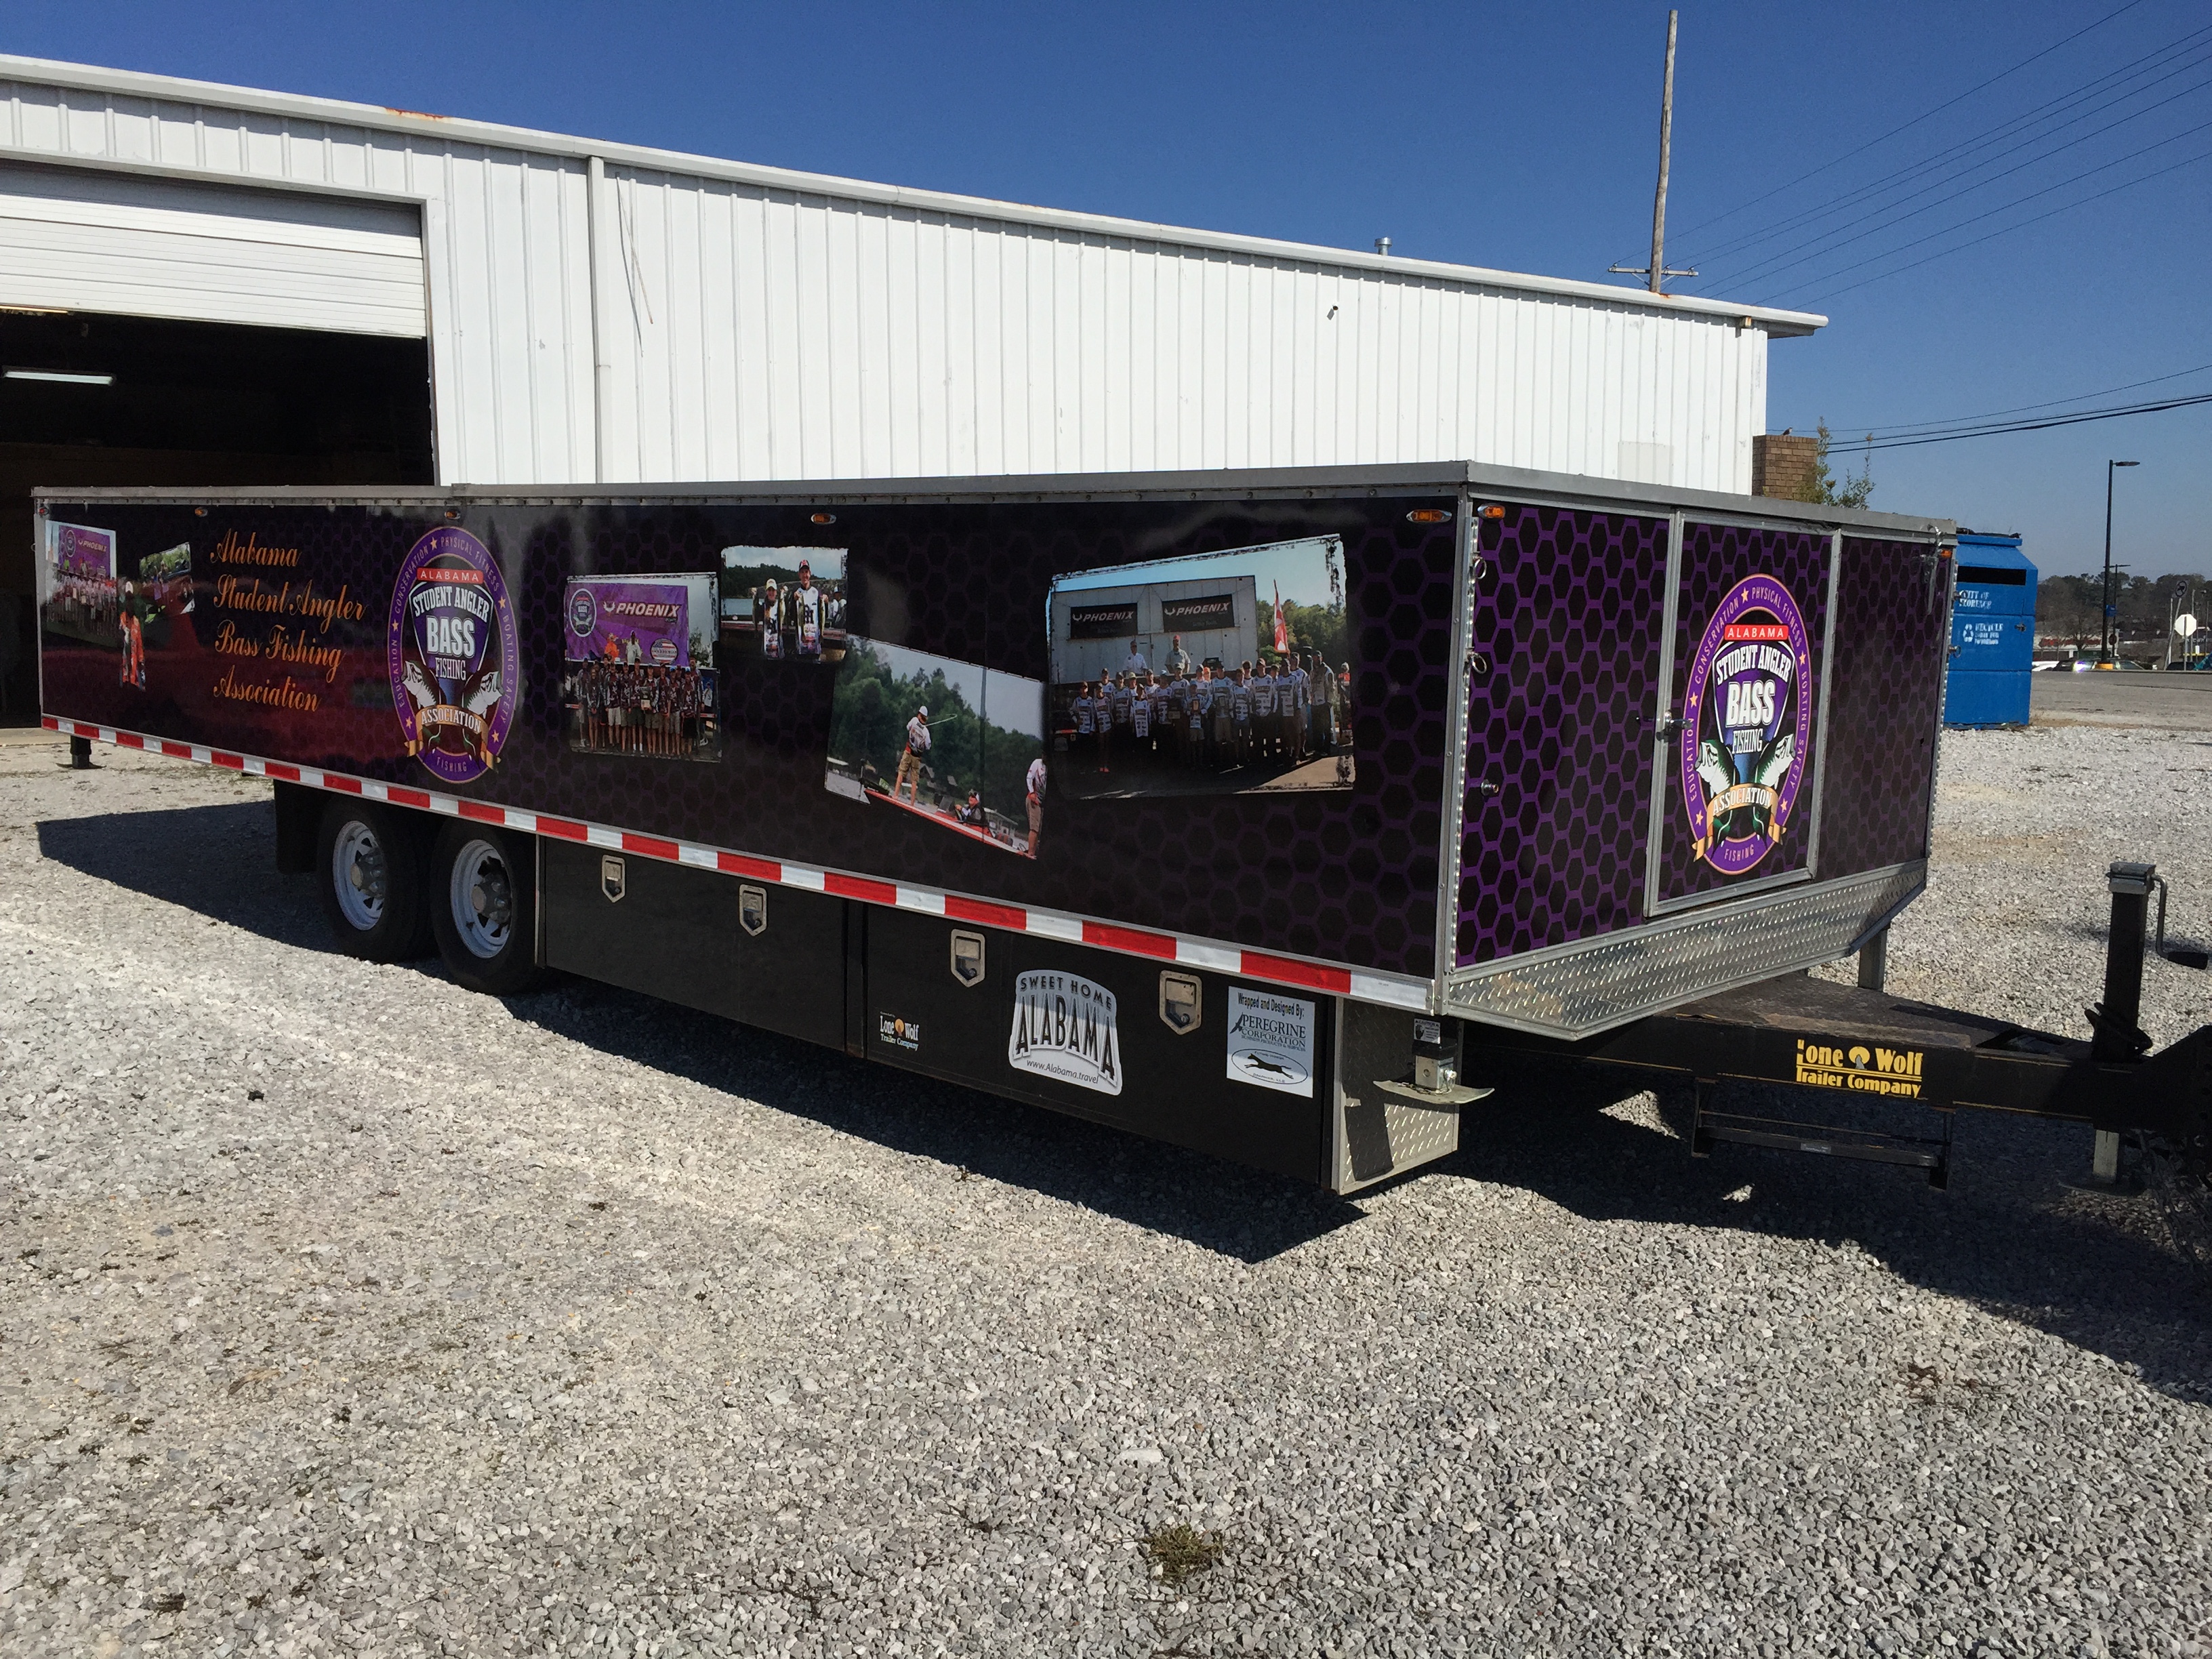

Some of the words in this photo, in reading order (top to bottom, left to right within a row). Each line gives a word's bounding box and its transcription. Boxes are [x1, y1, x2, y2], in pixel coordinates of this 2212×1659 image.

[209, 528, 302, 567] Alabama
[441, 536, 473, 555] PHYSICAL
[475, 551, 499, 592] FITNESS
[395, 545, 428, 614] CONSERVATION
[421, 570, 479, 581] ALABAMA
[213, 574, 289, 613] Student
[289, 579, 367, 634] Angler
[412, 586, 453, 617] STUDENT
[454, 586, 490, 623] ANGLER
[616, 602, 681, 617] PHOENIX
[1082, 611, 1134, 621] PHOENIX
[1176, 602, 1231, 615] PHOENIX
[1751, 587, 1782, 608] PHYSICAL
[1782, 602, 1802, 647] FITNESS
[426, 615, 474, 658] BASS
[502, 615, 514, 670] BOATING
[1695, 596, 1739, 684] CONSERVATION
[1727, 628, 1784, 638] ALABAMA
[215, 619, 262, 657] Bass
[265, 624, 346, 683] Fishing
[435, 657, 466, 680] FISHING
[1716, 644, 1758, 685] STUDENT
[1757, 644, 1791, 682] ANGLER
[213, 665, 321, 712] Association
[392, 639, 405, 708] EDUCATION
[500, 678, 514, 724] SAFETY
[1725, 679, 1776, 729] BASS
[421, 708, 482, 733] ASSOCIATION
[1732, 729, 1763, 754] FISHING
[436, 757, 467, 773] FISHING
[1790, 739, 1805, 789] SAFETY
[1713, 787, 1773, 816] ASSOCIATION
[1724, 844, 1754, 862] FISHING
[1020, 976, 1063, 991] SWEET
[1071, 980, 1111, 1010] HOME
[1237, 991, 1259, 1010] Wrapped
[1261, 998, 1269, 1010] and
[1271, 999, 1294, 1016] Designed
[1296, 1004, 1305, 1020] By:
[880, 1015, 895, 1035] Lone
[905, 1022, 920, 1041] Wolf
[1016, 993, 1115, 1081] ALABAMA
[1242, 1014, 1307, 1039] PEREGRINE
[1242, 1028, 1305, 1048] CORPORATION
[1027, 1059, 1099, 1084] www.Alabama.travel
[1797, 1039, 1844, 1067] Lone
[1875, 1048, 1923, 1076] Wolf
[1797, 1067, 1843, 1087] Trailer
[1847, 1074, 1921, 1099] Company
